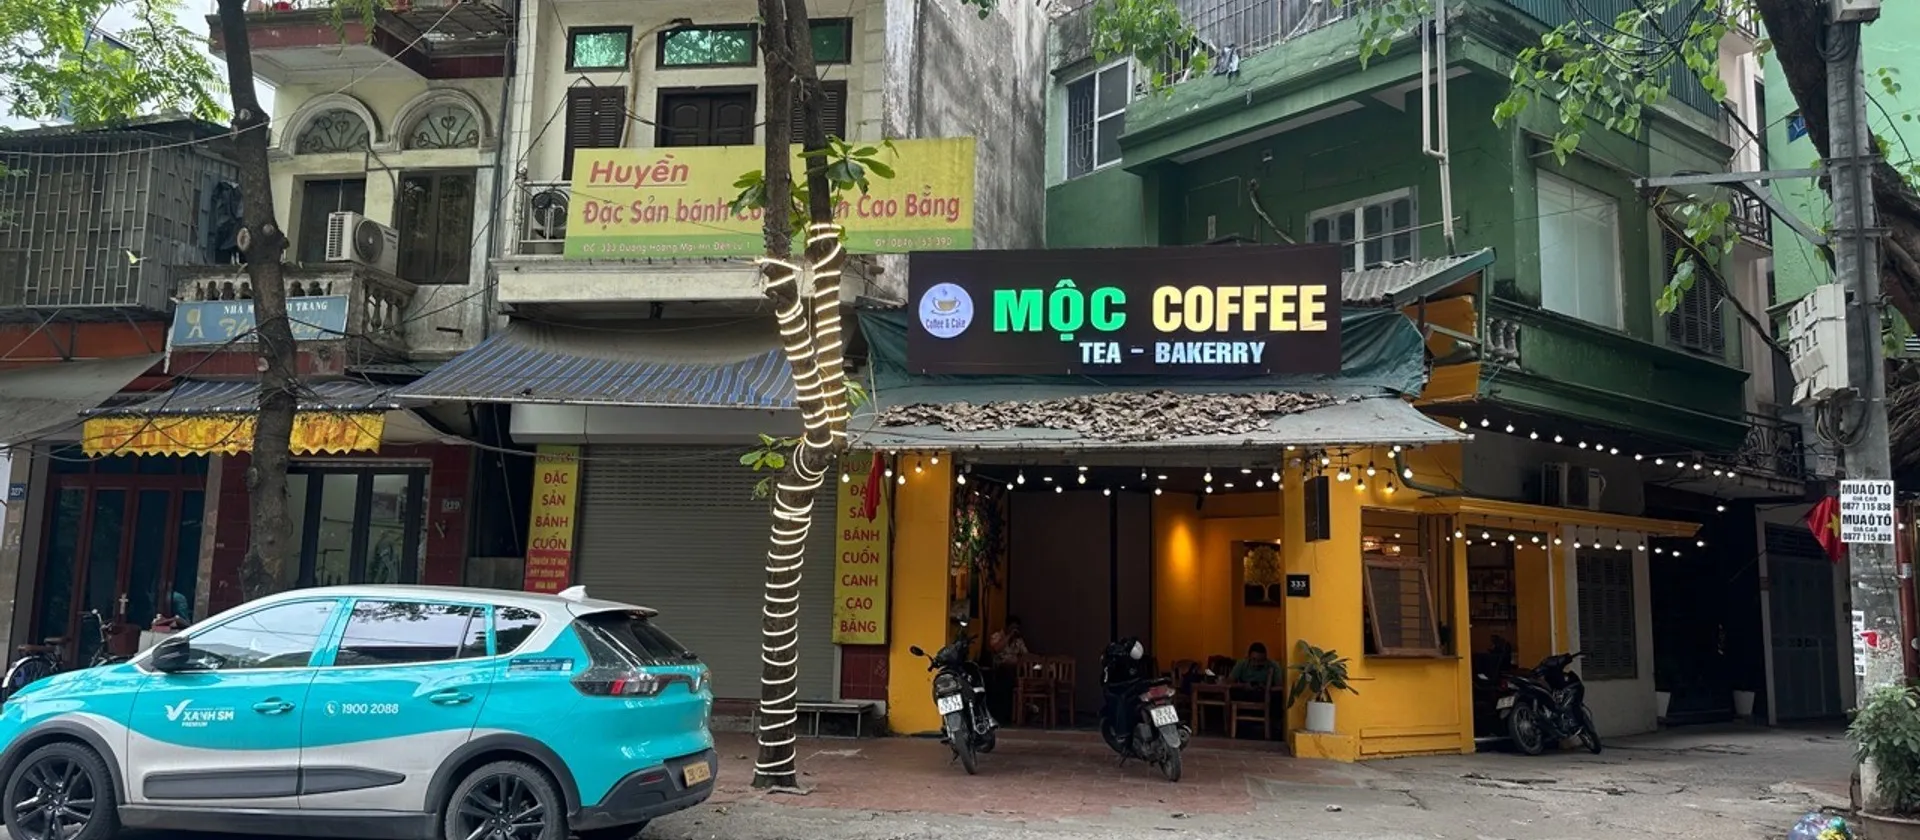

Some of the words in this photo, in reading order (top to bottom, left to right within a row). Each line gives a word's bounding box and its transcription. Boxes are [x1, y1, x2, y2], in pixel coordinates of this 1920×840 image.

[589, 153, 689, 189] Huyền
[583, 199, 624, 230] Đặc
[629, 195, 669, 223] Sản
[675, 197, 728, 223] bánh
[856, 192, 898, 219] Cao
[296, 301, 328, 312] TRANG
[993, 278, 1127, 341] MỘC
[1152, 284, 1328, 332] COFFEE
[1079, 341, 1122, 365] TEA
[1155, 341, 1266, 365] BAKERRY
[544, 470, 569, 488] ĐẶC
[541, 490, 566, 506] SẢN
[1842, 502, 1860, 510] 0877
[1862, 503, 1876, 511] 115
[1877, 503, 1891, 511] 838
[534, 513, 569, 528] BÁNH
[532, 531, 567, 549] CUỐN
[844, 525, 880, 541] BÁNH
[1843, 533, 1860, 541] 0877
[1863, 533, 1876, 541] 115
[1878, 533, 1892, 542] 838
[842, 544, 880, 564] CUỐN
[842, 574, 879, 587] CANH
[1290, 580, 1306, 588] 333
[846, 597, 872, 610] CAO
[840, 613, 877, 633] BẰNG
[183, 710, 216, 722] XANH
[217, 710, 235, 722] SM
[341, 703, 368, 716] 1900
[370, 703, 399, 716] 2088
